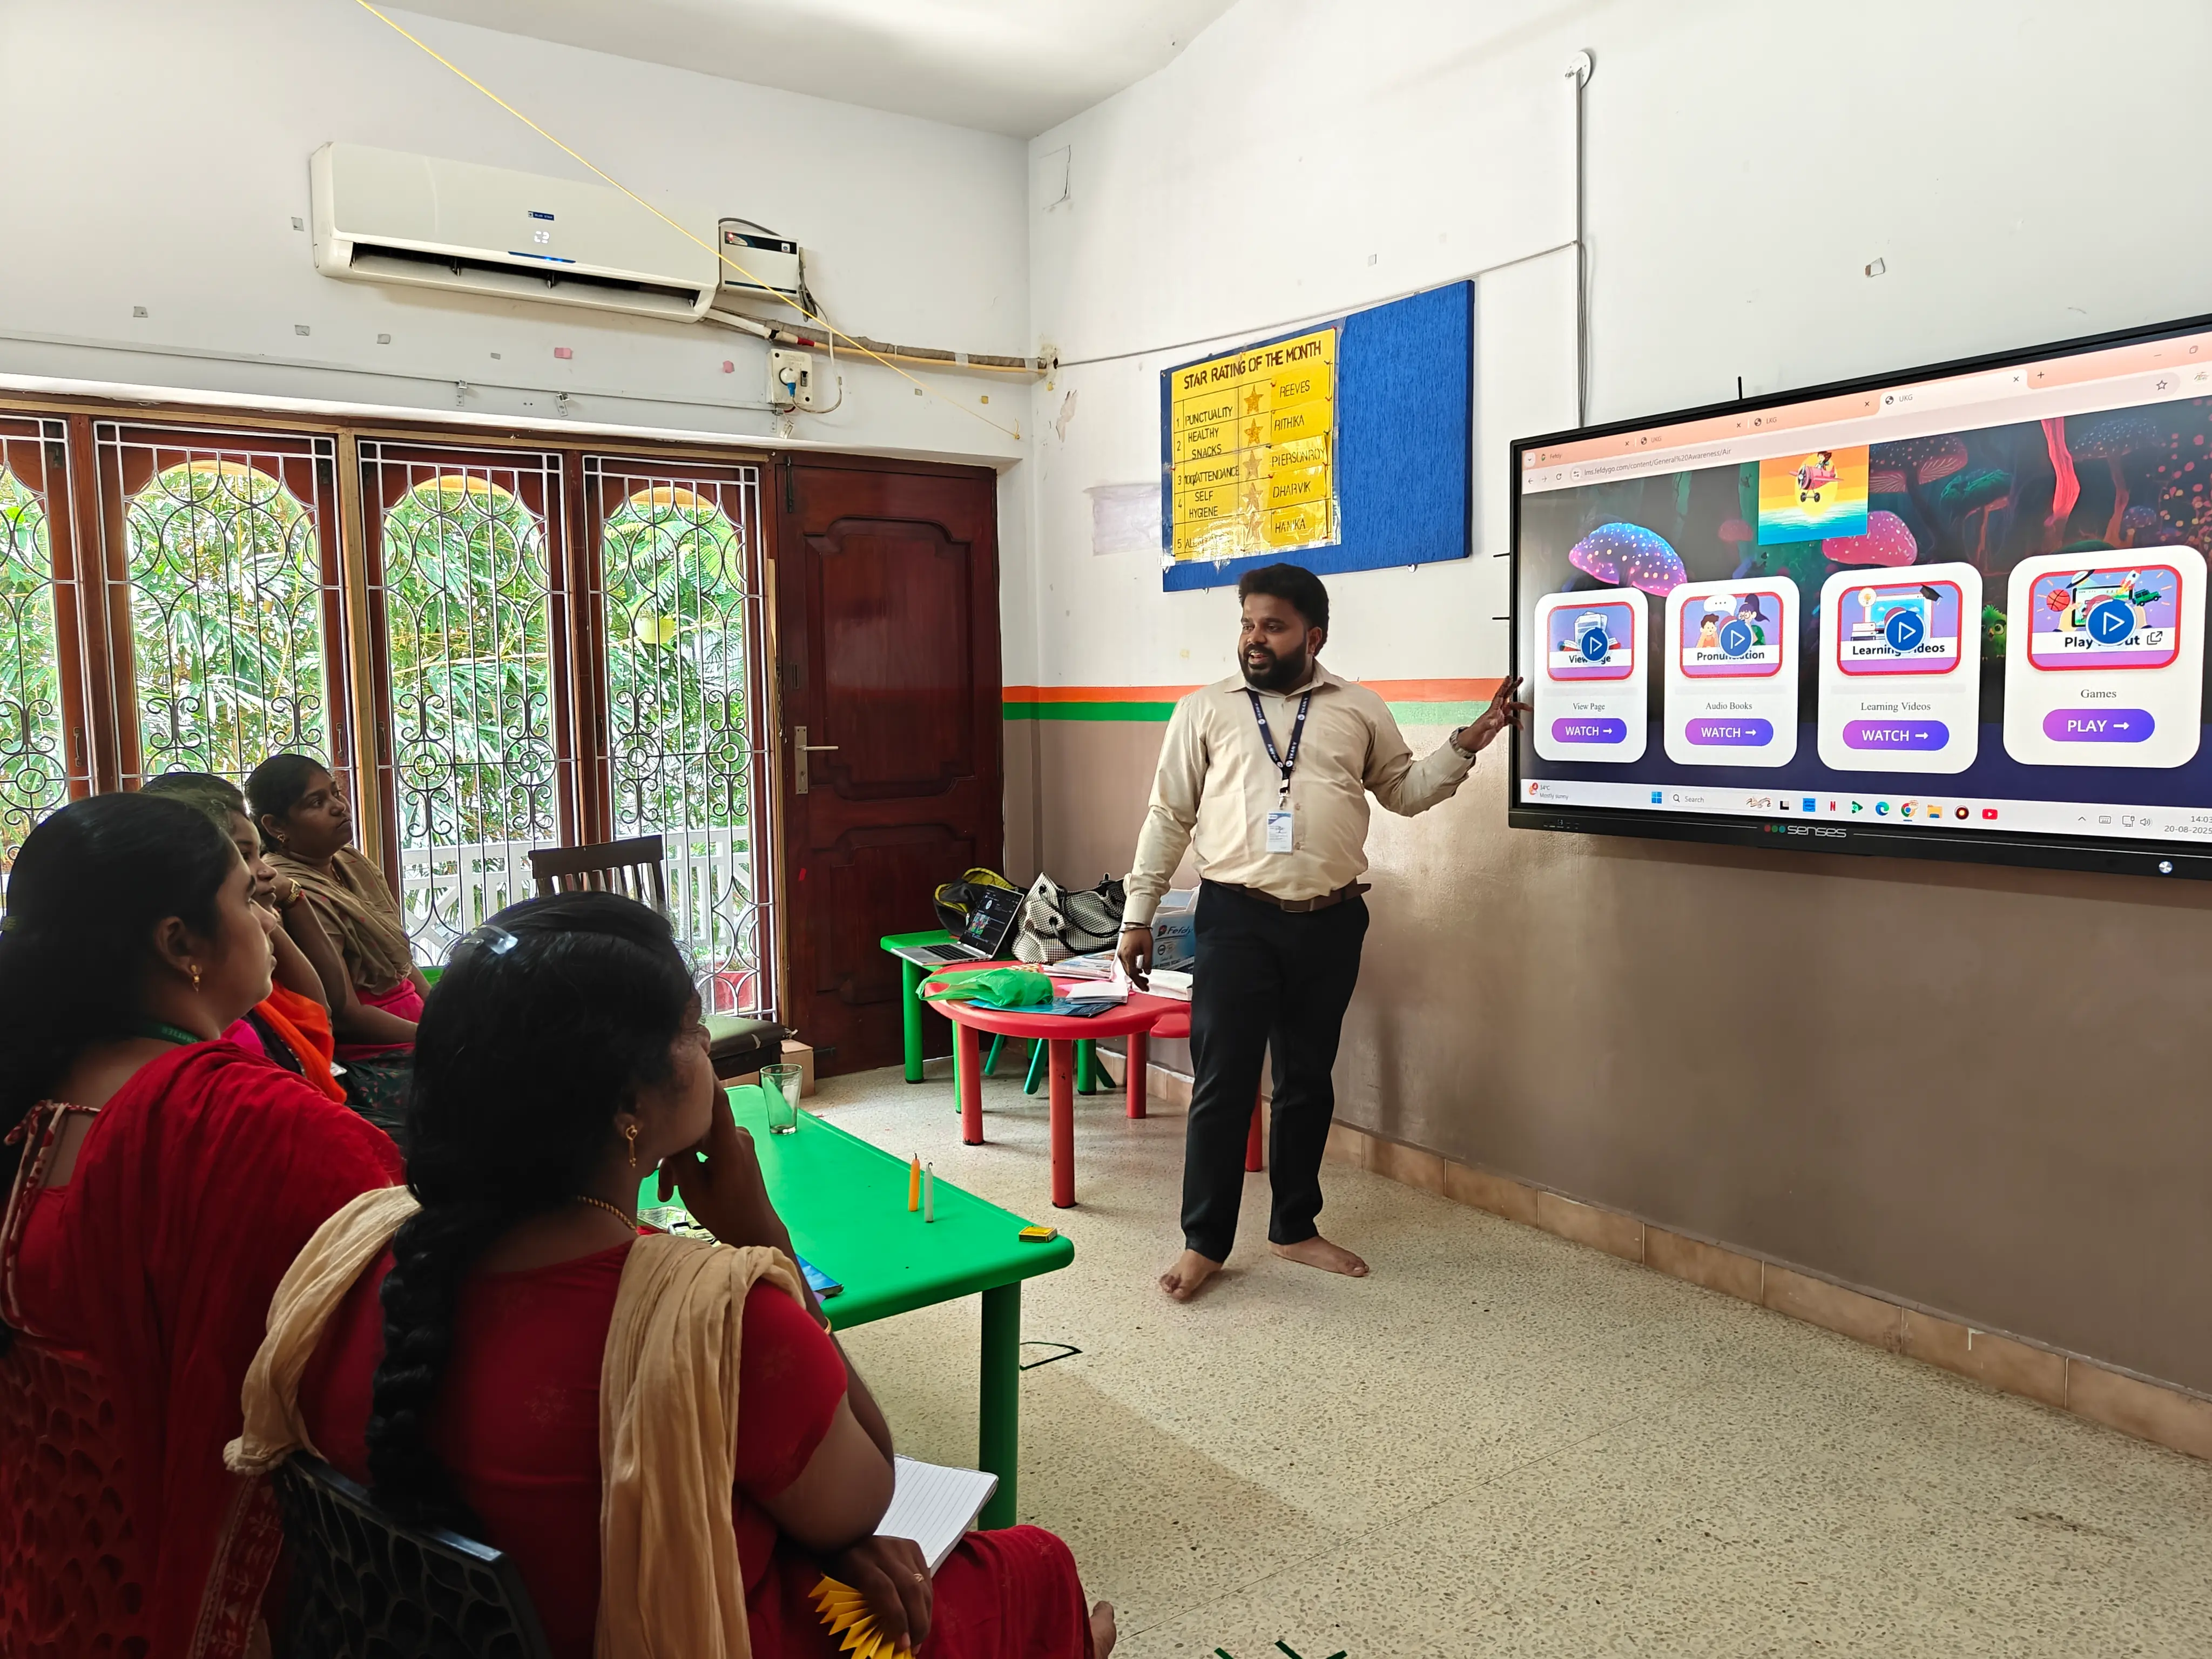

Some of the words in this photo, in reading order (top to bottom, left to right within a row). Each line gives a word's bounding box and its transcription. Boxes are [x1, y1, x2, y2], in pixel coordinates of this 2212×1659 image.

[1184, 370, 1207, 389] STAR
[1211, 360, 1246, 382] RATING
[1249, 355, 1263, 372] OF
[1265, 350, 1283, 367] THE
[1286, 340, 1321, 363] MONTH
[1280, 380, 1310, 398] REEVES
[1899, 394, 1913, 402] UKG
[1177, 417, 1179, 427] 1
[1185, 406, 1233, 426] PUNCTUALITY
[1274, 414, 1304, 431] RITHIKA
[1188, 427, 1219, 443] HEALTHY
[1177, 440, 1181, 451] 2
[1191, 444, 1222, 459] SNACKS
[1178, 475, 1182, 485] 3
[1273, 481, 1311, 498] DHARVIK
[1195, 490, 1213, 502] SELF
[1178, 498, 1182, 508] 4
[1189, 506, 1218, 518] HYGIENE
[1177, 538, 1182, 548] 5
[2065, 637, 2093, 650] Play
[2081, 689, 2117, 698] Games
[1590, 703, 1605, 712] Page
[1861, 702, 1899, 712] Learning
[1901, 702, 1931, 711] Videos
[1565, 726, 1599, 736] WATCH
[2067, 720, 2107, 732] PLAY
[1701, 727, 1741, 738] WATCH
[1862, 730, 1909, 741] WATCH
[1788, 825, 1846, 838] senses
[2164, 825, 2212, 834] 20-08-2025
